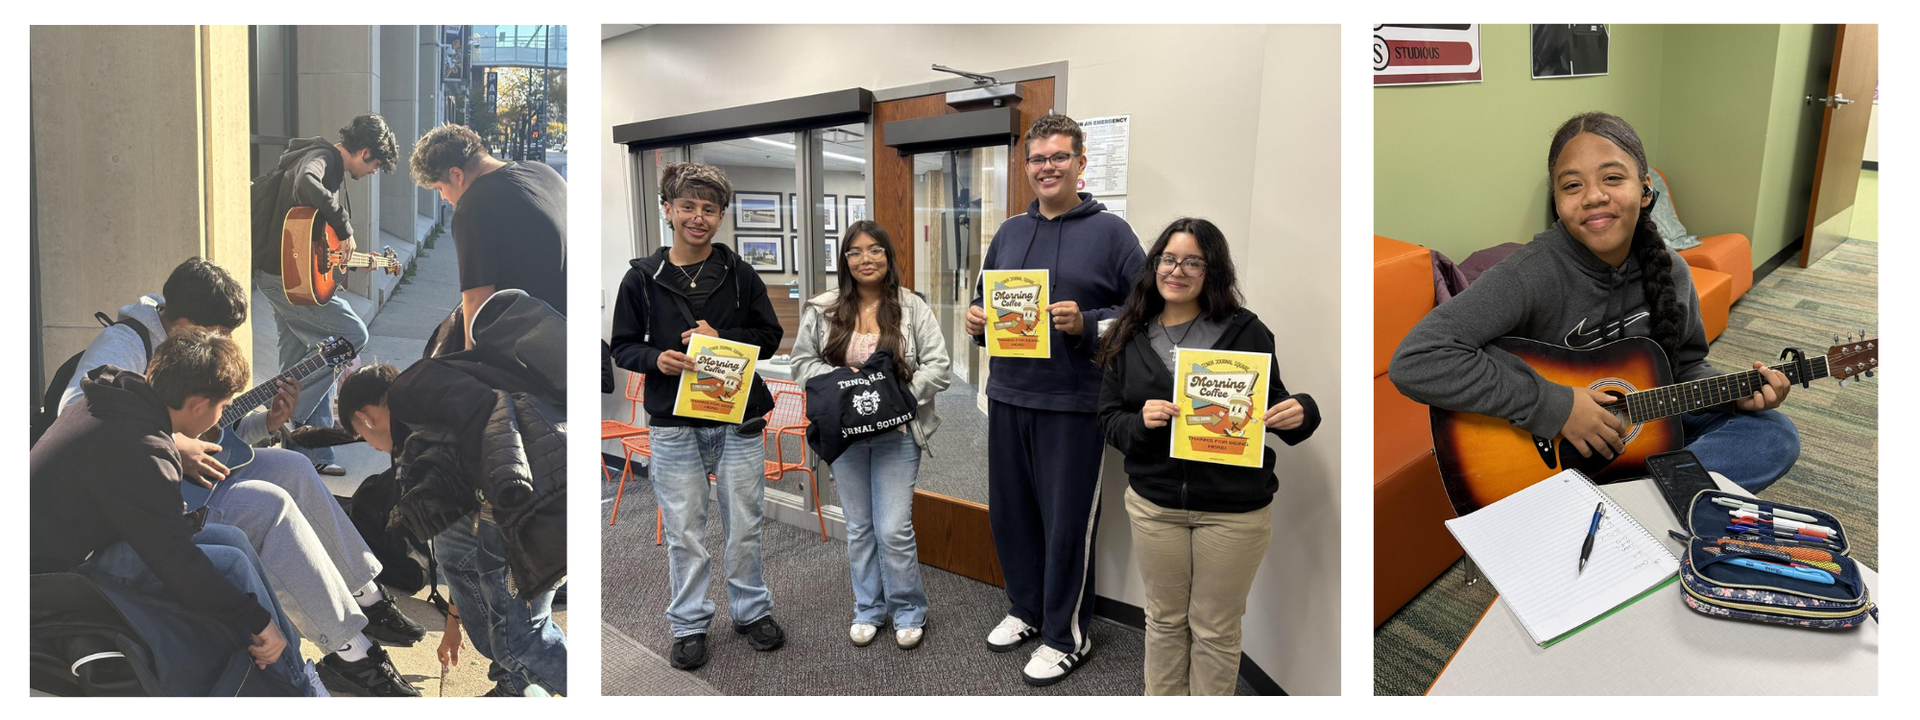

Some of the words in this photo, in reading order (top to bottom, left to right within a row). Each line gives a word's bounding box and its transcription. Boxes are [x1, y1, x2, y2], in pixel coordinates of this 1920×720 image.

[1395, 47, 1439, 59] STUDIOUS
[994, 291, 1034, 301] Morning
[697, 356, 740, 371] Morning
[704, 365, 726, 374] Coffee
[838, 378, 871, 389] TENOR
[868, 371, 886, 383] H.S.
[1190, 376, 1247, 393] Morning
[1199, 388, 1229, 398] Coffee
